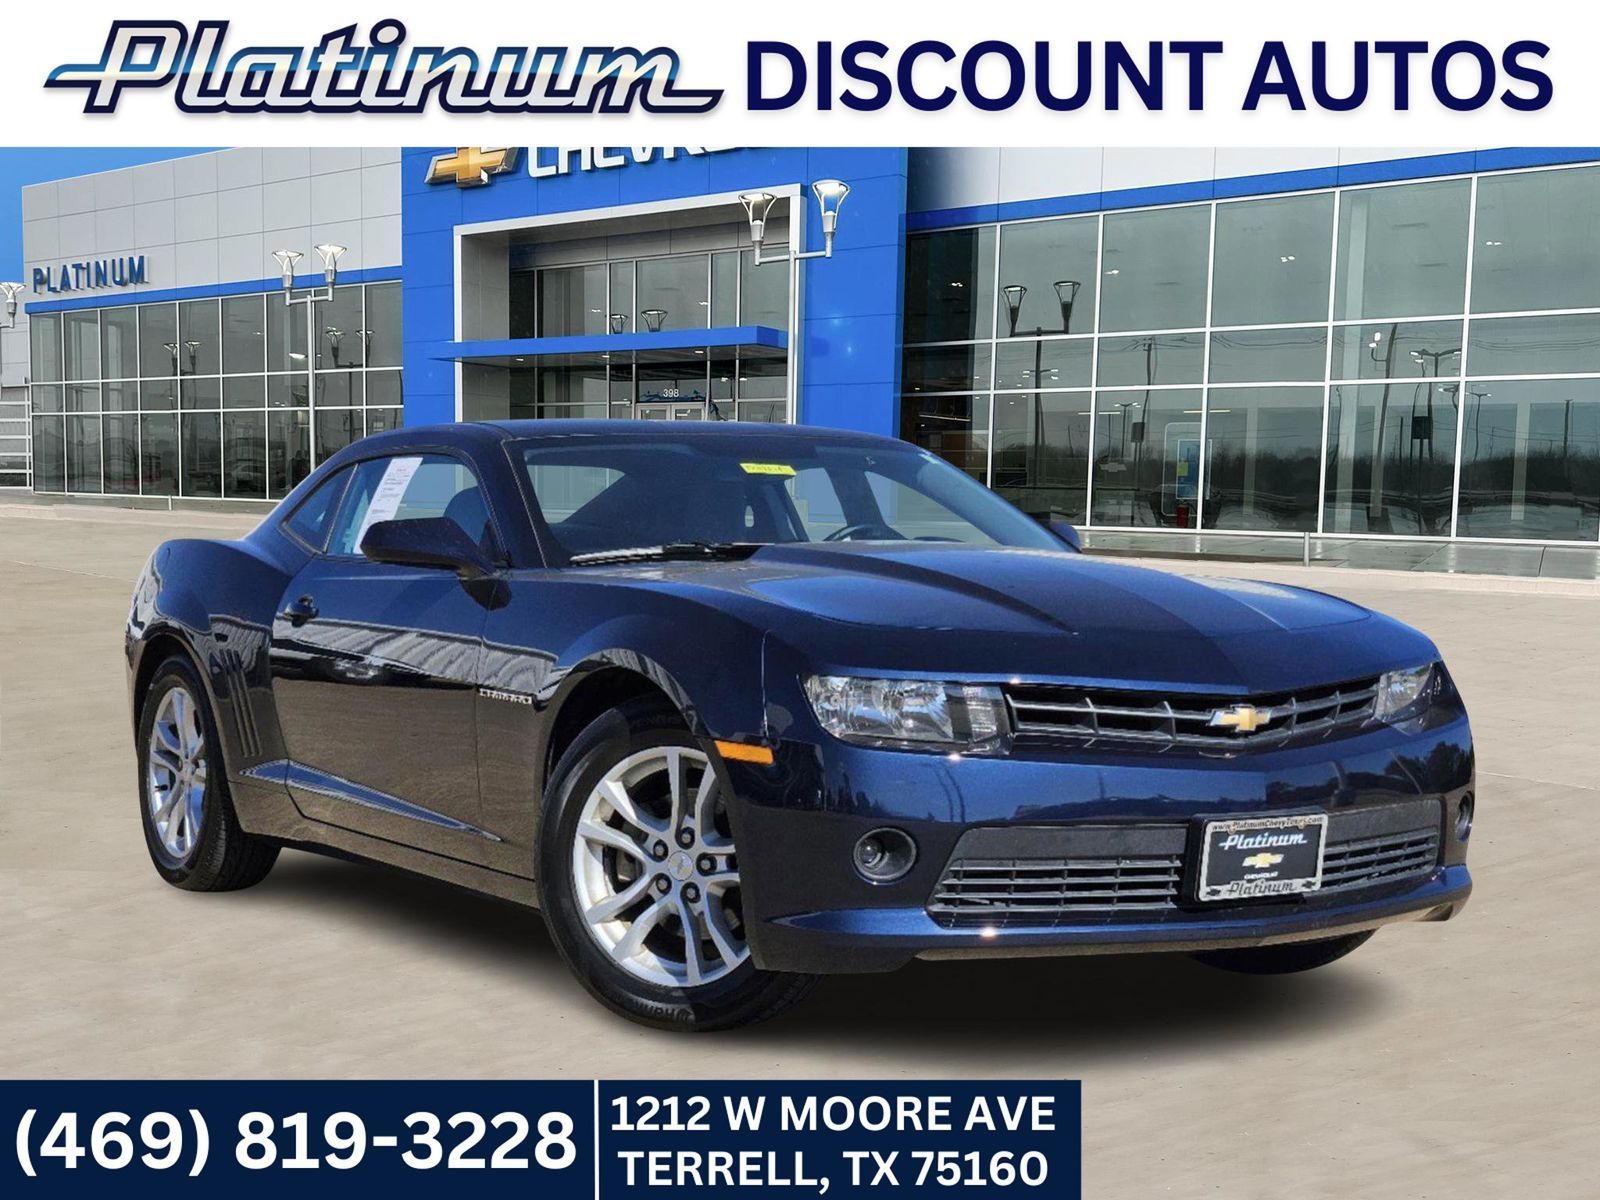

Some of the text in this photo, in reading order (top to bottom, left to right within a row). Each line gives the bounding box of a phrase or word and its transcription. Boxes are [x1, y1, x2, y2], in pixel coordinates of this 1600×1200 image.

[33, 255, 147, 294] PLATINUM
[663, 388, 679, 398] 398
[479, 688, 532, 704] CAMARO
[1218, 832, 1308, 850] Platinum
[1226, 880, 1297, 897] Platinum
